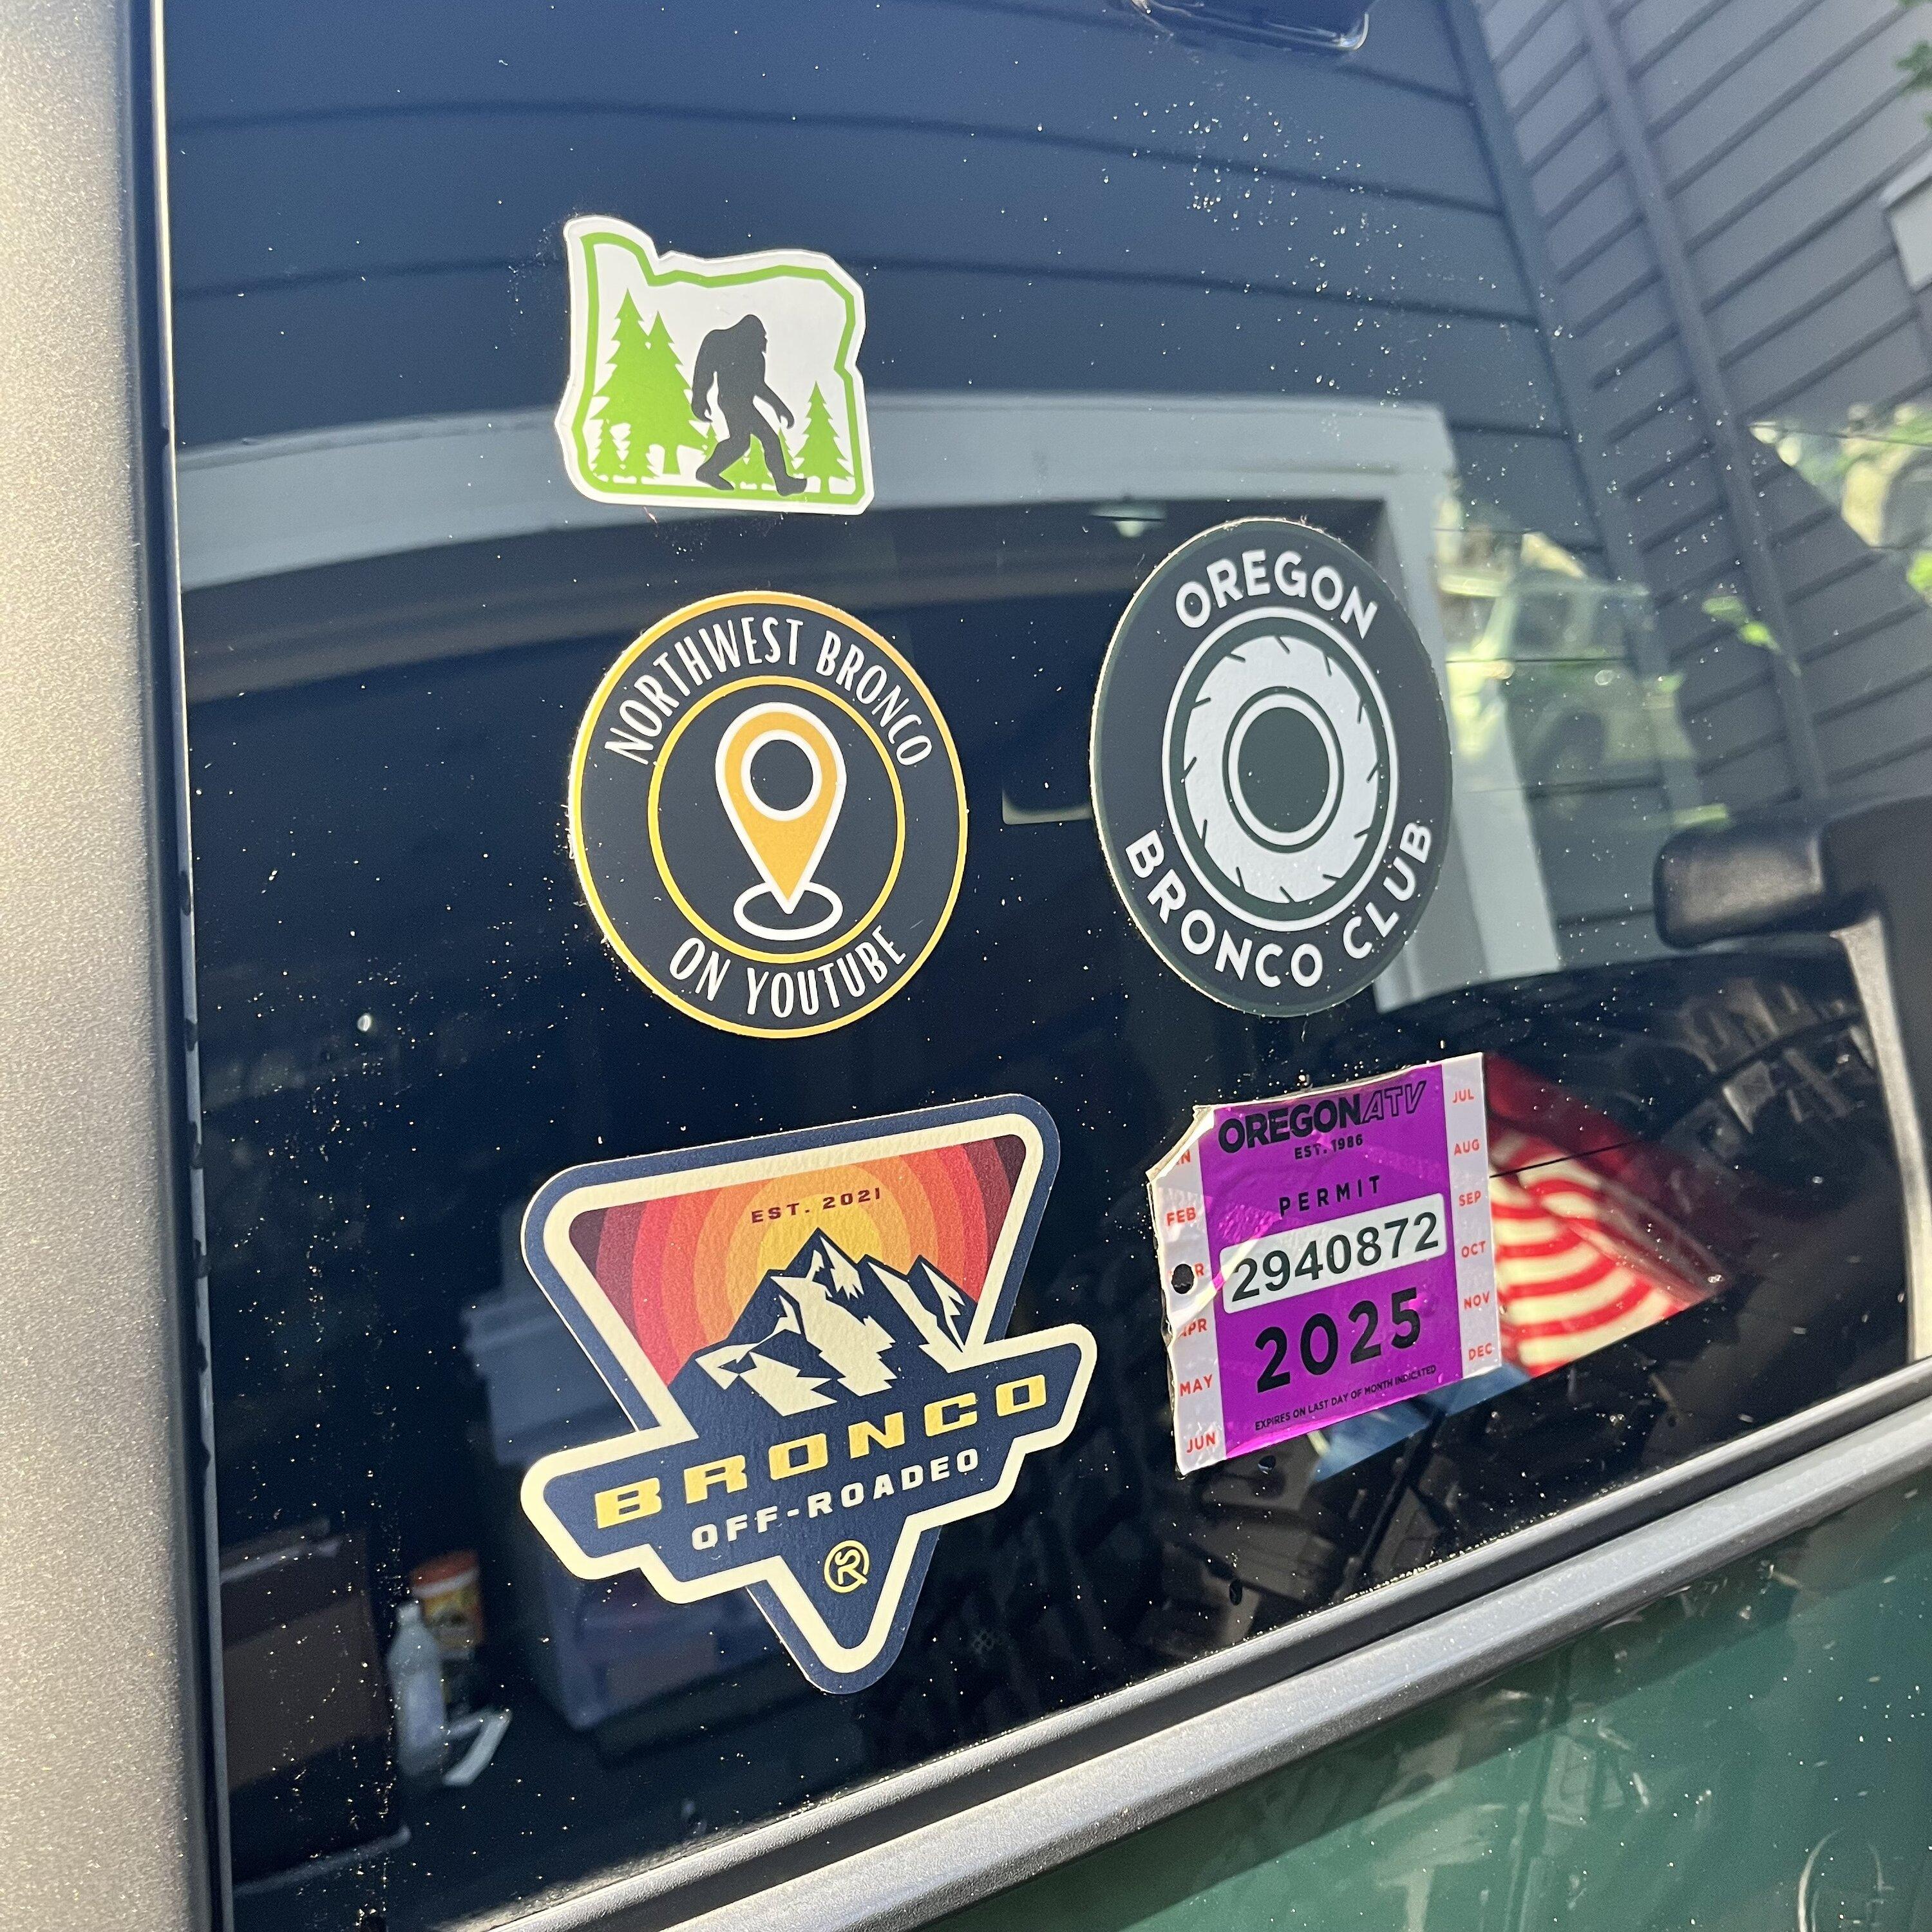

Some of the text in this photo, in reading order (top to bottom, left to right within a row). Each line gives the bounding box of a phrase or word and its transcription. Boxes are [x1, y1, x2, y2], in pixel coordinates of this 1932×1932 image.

[1175, 549, 1378, 639] OREGON
[603, 616, 933, 766] NORTHWEST BRONCO
[1124, 822, 1433, 989] BRONCO CLUB
[669, 925, 907, 1019] ON YOUTUBE
[1452, 1087, 1475, 1104] JUL
[1331, 1133, 1364, 1153] 1986
[1454, 1139, 1481, 1156] AUG
[750, 1187, 882, 1224] EST. 2021
[1279, 1175, 1380, 1217] PERMIT
[1458, 1190, 1482, 1208] SEP
[1166, 1206, 1197, 1226] FEB
[1231, 1211, 1438, 1302] 2940872
[1461, 1240, 1486, 1258] OCT
[1463, 1291, 1490, 1309] NOV
[1254, 1287, 1421, 1393] 2025
[1468, 1342, 1493, 1361] DEC
[1179, 1374, 1213, 1396] MAY
[1255, 1364, 1437, 1431] EXPIRES ON LAST DAY OF MONTH INDICATED
[594, 1374, 1048, 1529] BRONCO
[1186, 1431, 1216, 1454] JUN
[692, 1448, 980, 1550] OFF-ROADEO
